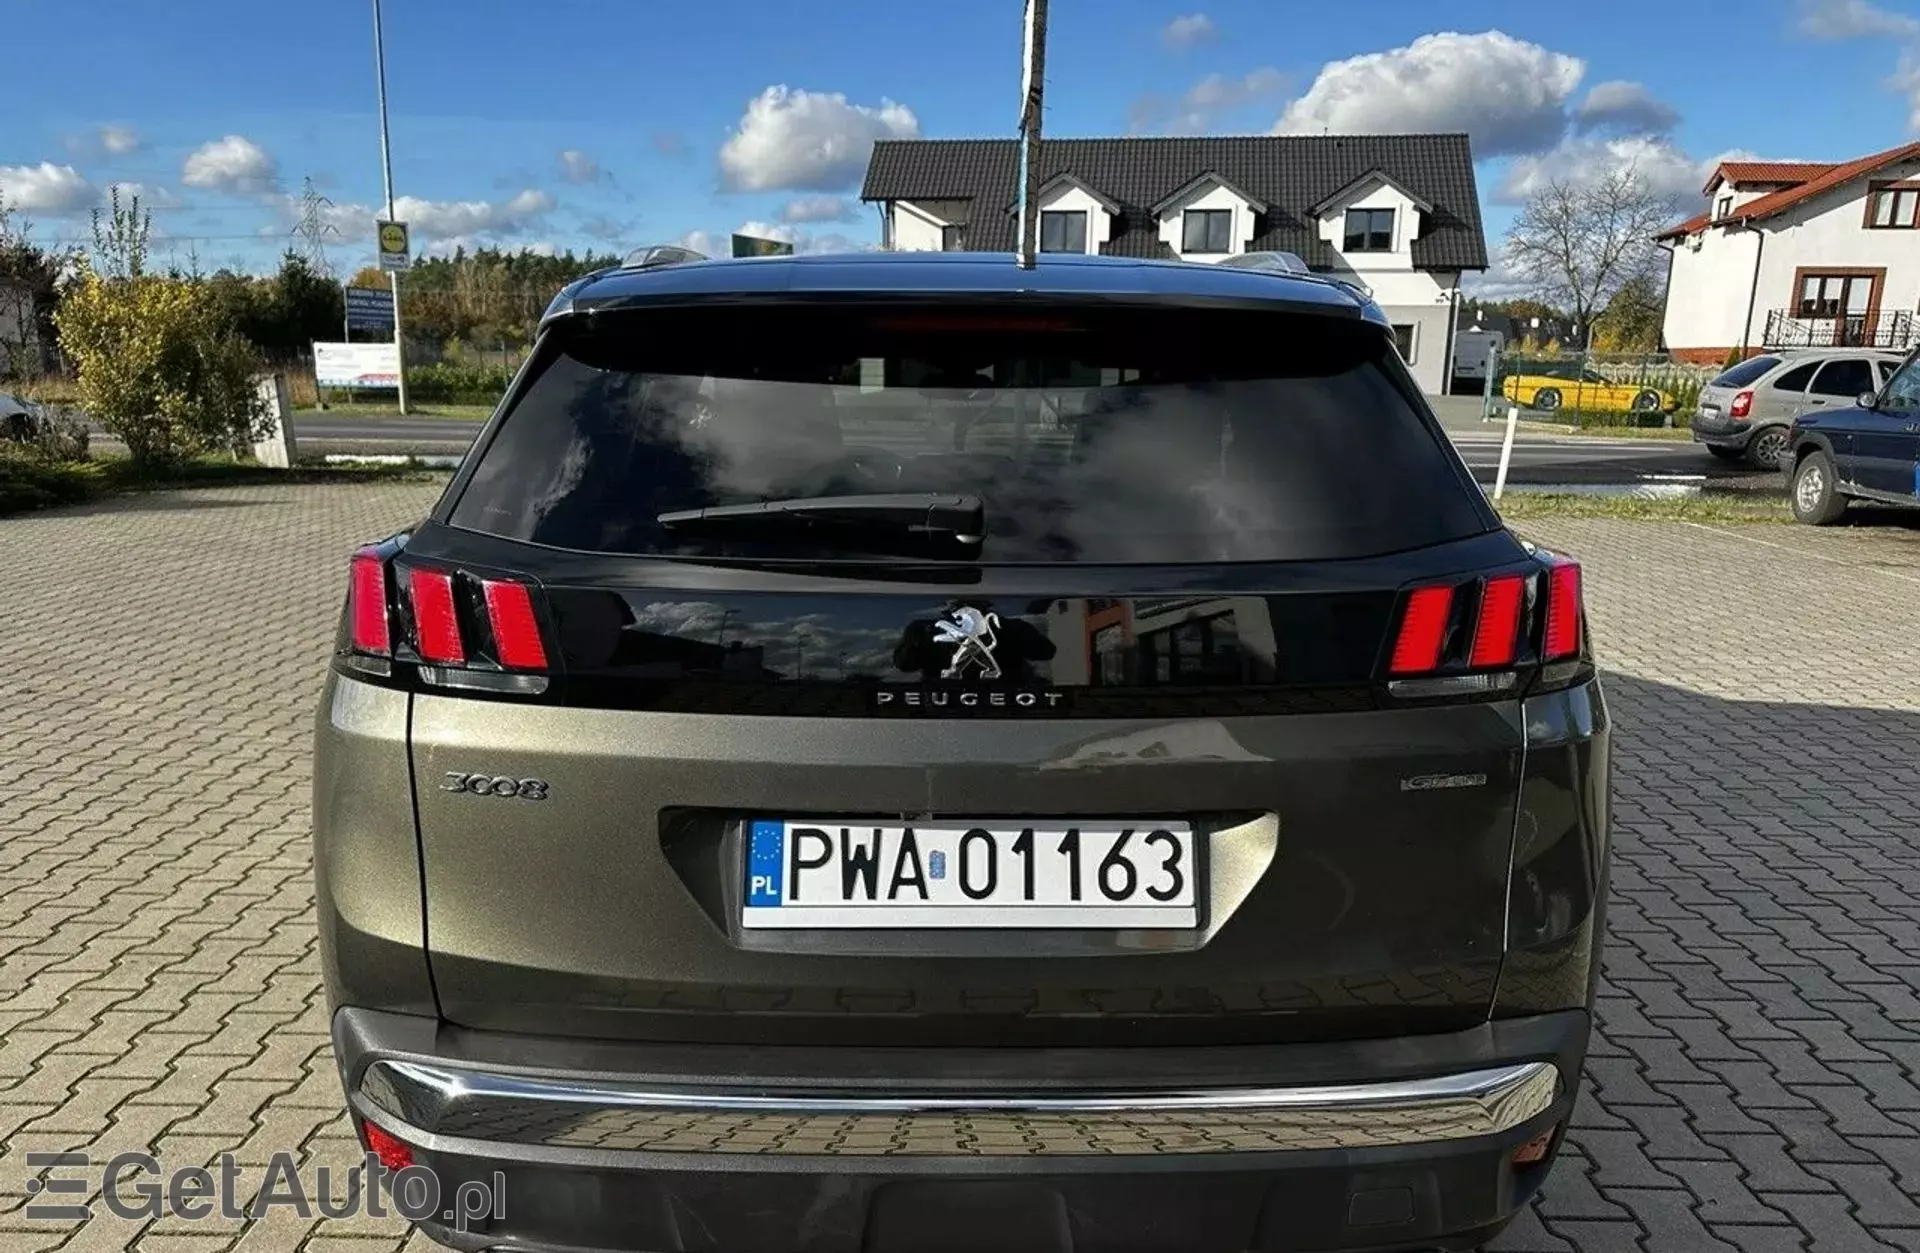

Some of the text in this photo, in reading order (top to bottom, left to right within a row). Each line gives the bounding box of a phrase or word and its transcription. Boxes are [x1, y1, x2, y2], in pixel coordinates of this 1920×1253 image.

[876, 691, 1063, 707] PEUGEOT
[439, 770, 549, 801] 3008
[788, 827, 1186, 902] PWA 01163
[750, 875, 777, 896] PL
